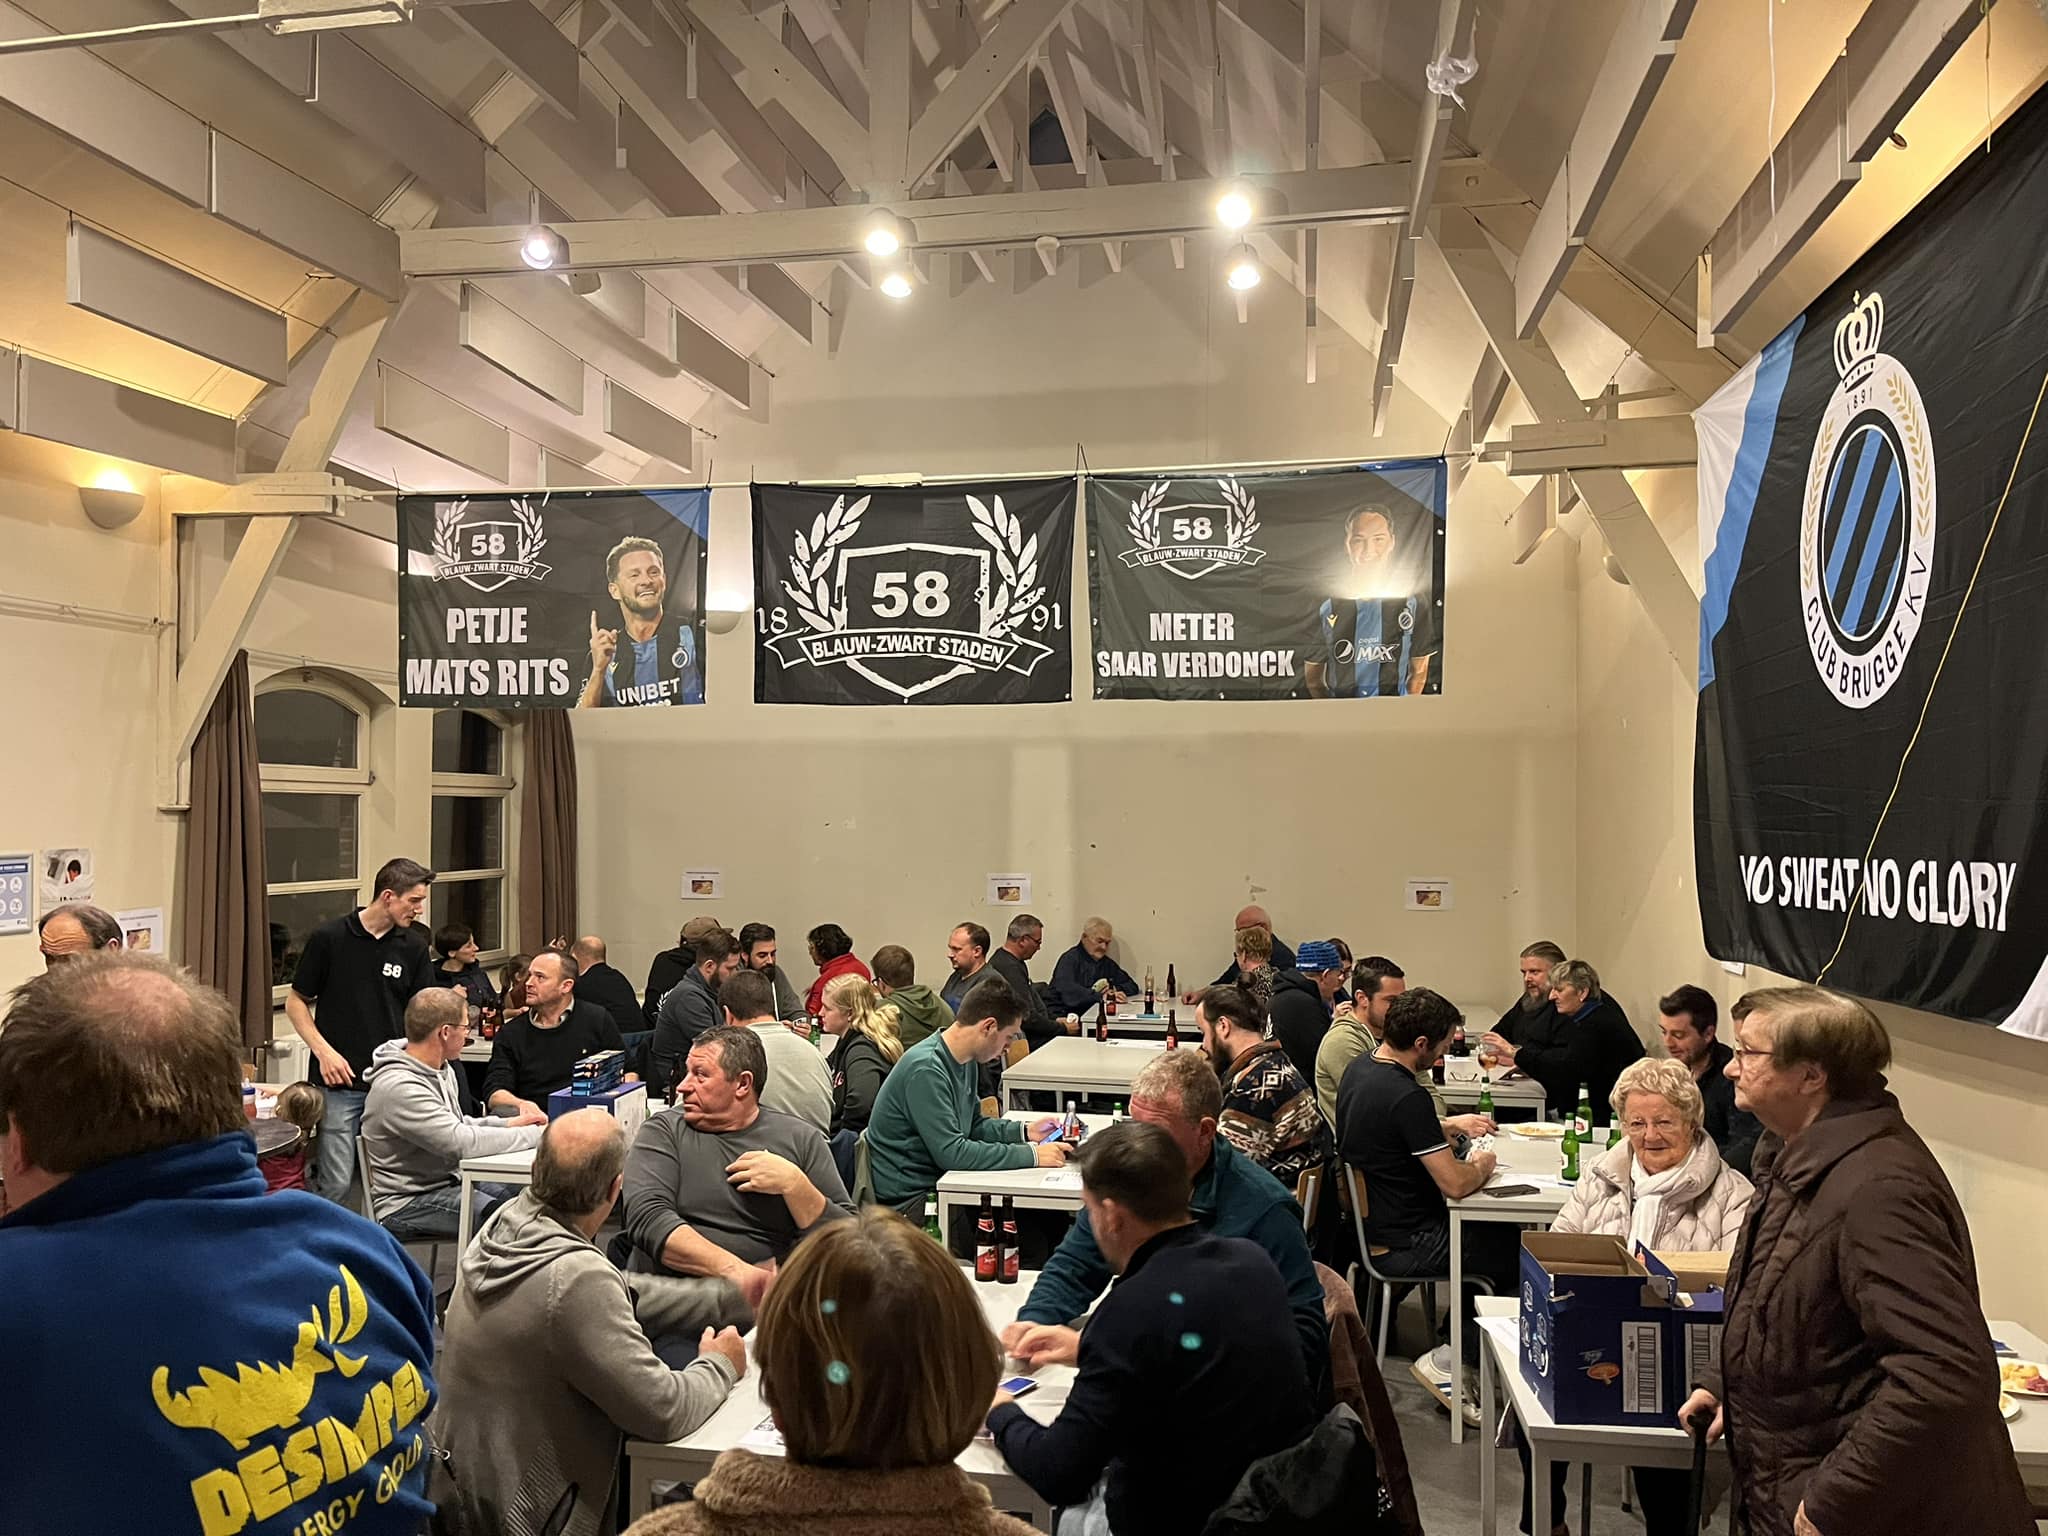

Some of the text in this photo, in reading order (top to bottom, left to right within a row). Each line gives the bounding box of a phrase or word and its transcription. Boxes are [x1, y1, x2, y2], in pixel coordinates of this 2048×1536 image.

[1846, 386, 1875, 418] 1891
[1172, 517, 1213, 541] 58
[471, 533, 506, 556] 58
[1142, 548, 1241, 563] BLAUW-ZWART STADEN
[443, 561, 531, 576] BLAUW-ZWART STADEN
[871, 571, 950, 618] 58
[446, 607, 528, 644] PETJE
[755, 605, 790, 635] 18
[1030, 602, 1065, 633] 91
[1149, 612, 1235, 642] METER
[811, 632, 1005, 664] BLAUW-ZWART STADEN
[1806, 594, 1838, 680] CLUB
[1838, 618, 1907, 700] BRUGGE
[406, 658, 570, 696] MATS RITS
[1096, 650, 1296, 679] SAAR VERDONCK
[616, 677, 681, 705] UNIBET
[1778, 856, 1860, 913] SWEAT
[1861, 858, 1901, 920] NO
[1906, 859, 2017, 932] GLORY
[382, 962, 402, 978] 58
